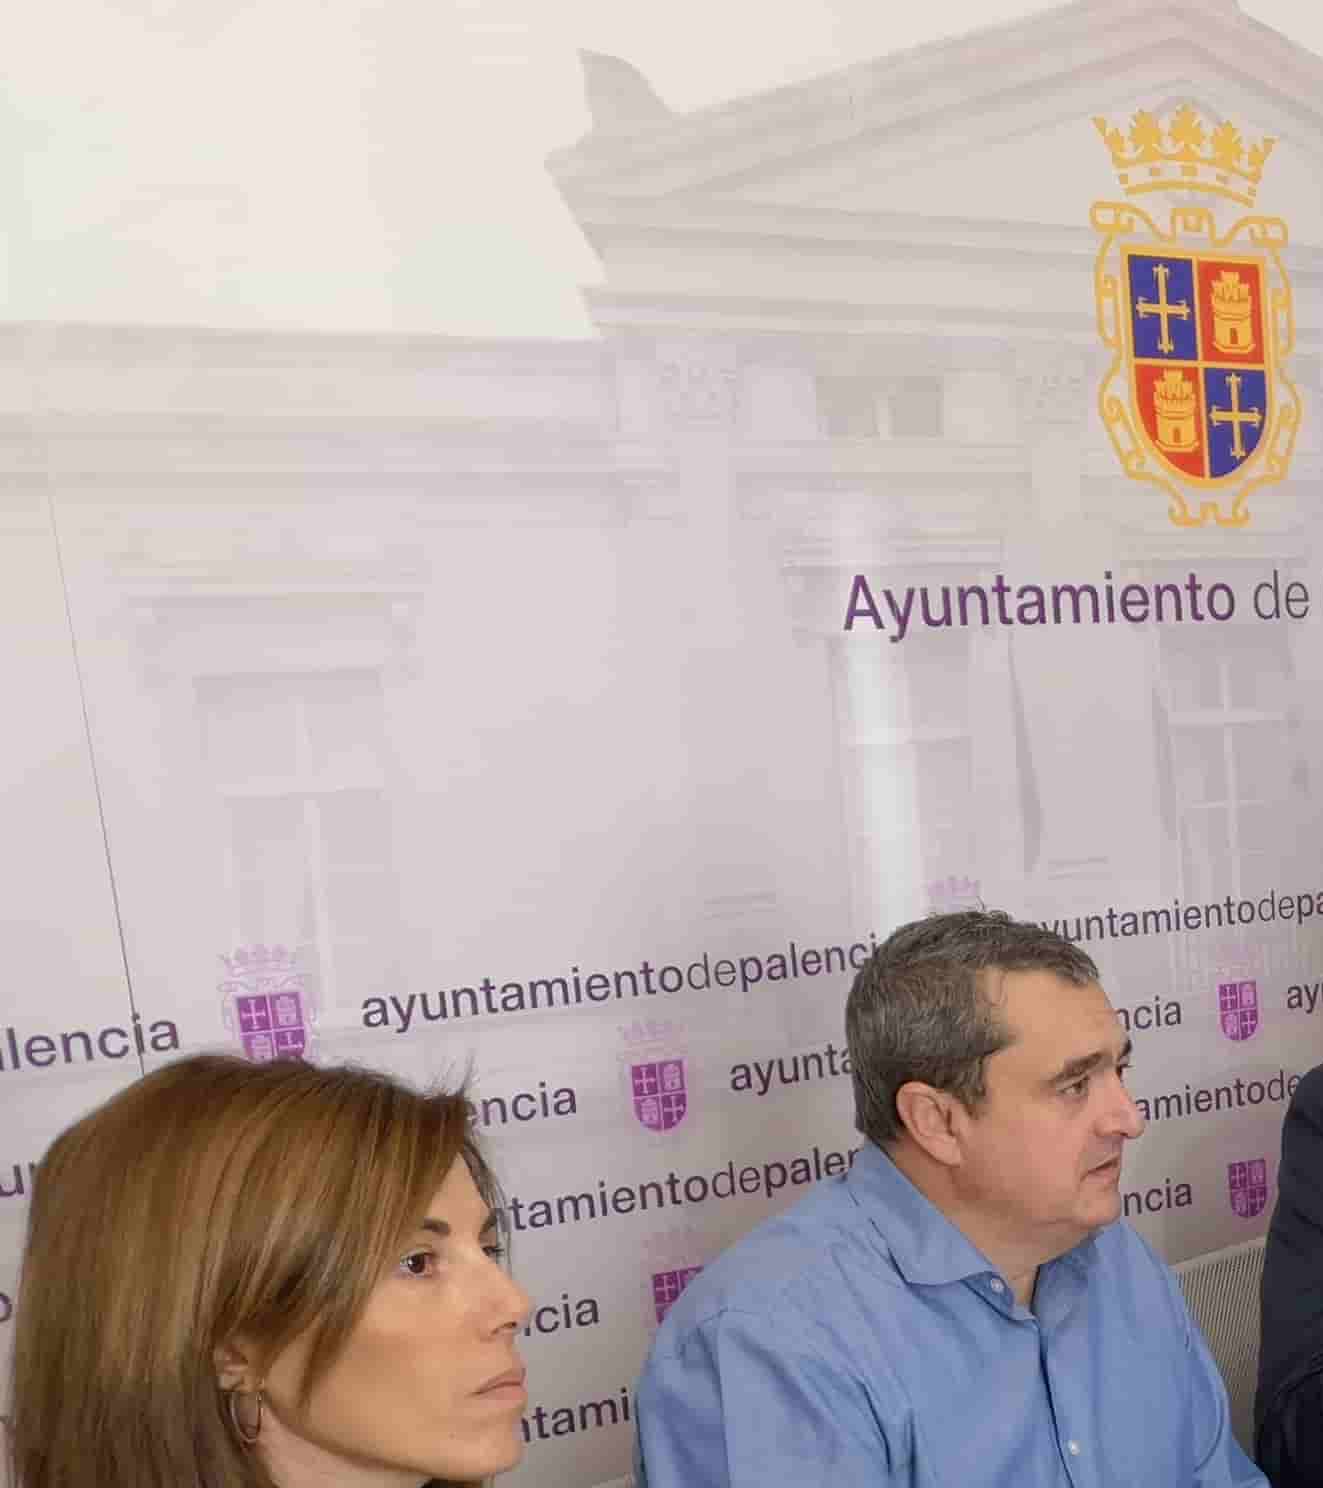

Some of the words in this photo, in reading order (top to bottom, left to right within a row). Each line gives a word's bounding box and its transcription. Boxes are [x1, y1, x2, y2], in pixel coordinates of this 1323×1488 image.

[843, 570, 1237, 644] Ayuntamiento
[1254, 570, 1311, 620] de
[361, 932, 880, 1034] ayuntamientodepalenci
